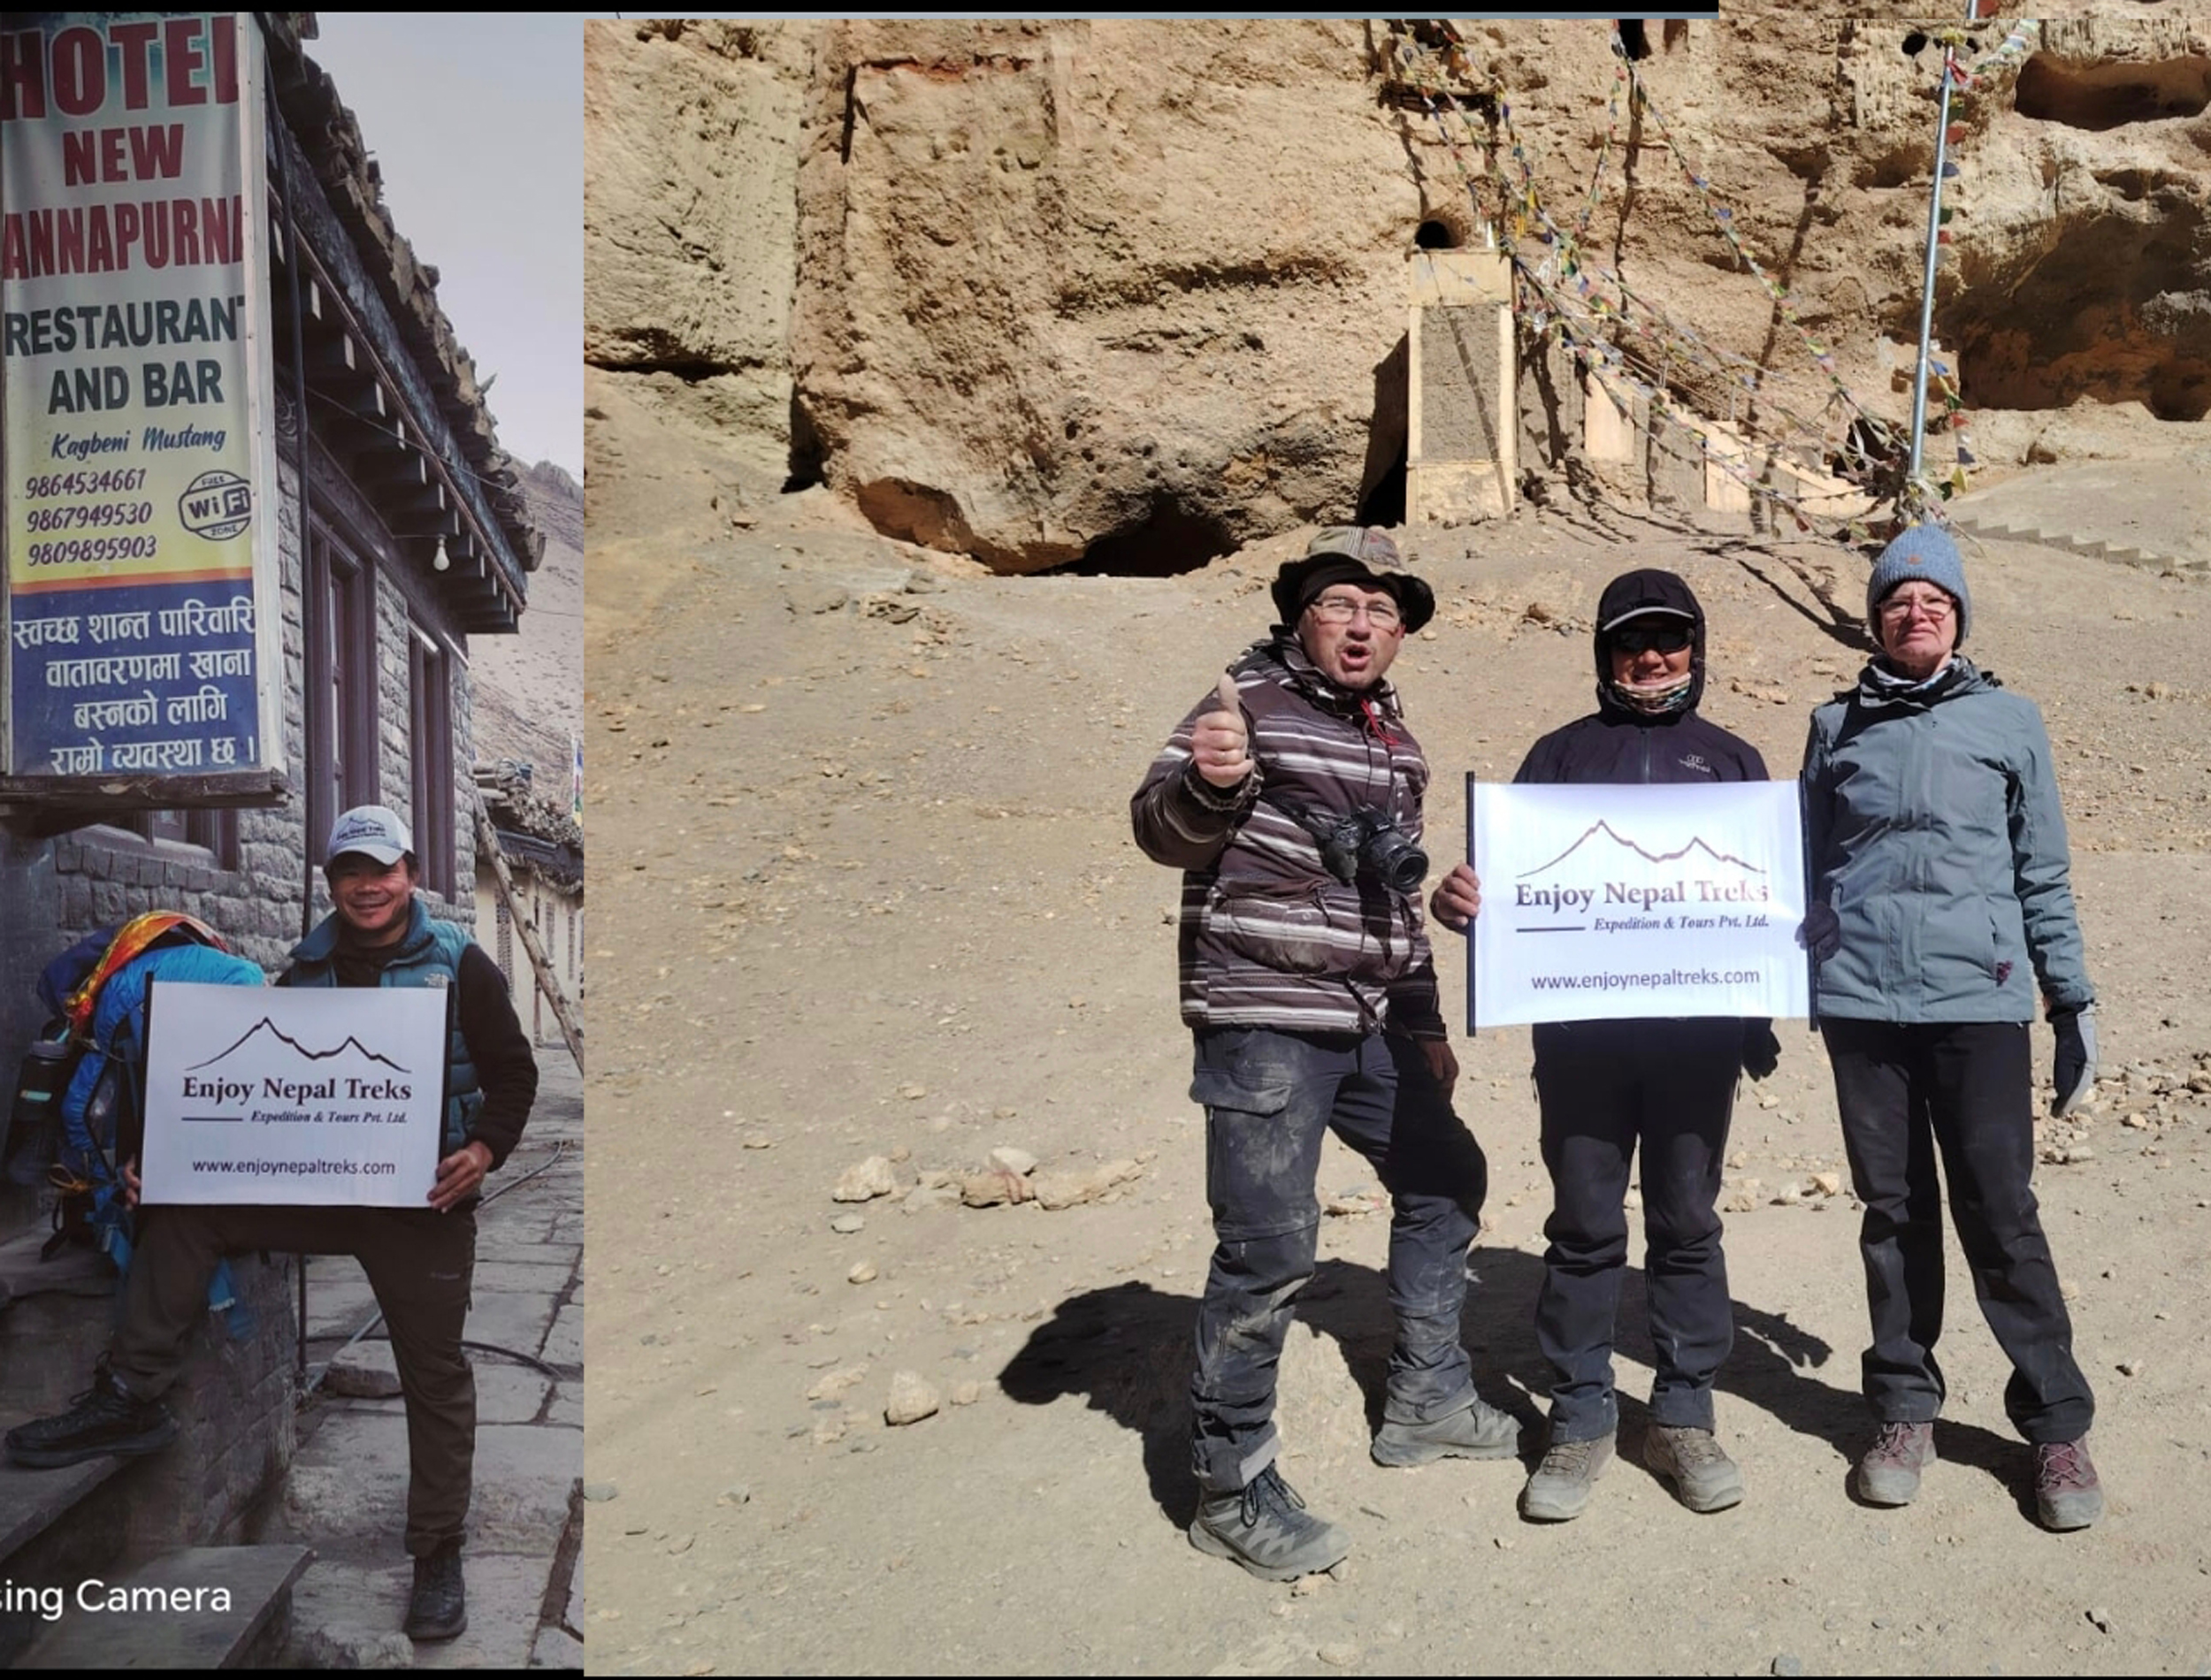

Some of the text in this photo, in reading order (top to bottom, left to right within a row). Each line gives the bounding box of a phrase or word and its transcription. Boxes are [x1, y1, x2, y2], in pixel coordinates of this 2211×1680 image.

[63, 124, 184, 187] NEW
[48, 359, 225, 415] AND BAR
[50, 423, 226, 462] Kagbeni Mustang
[25, 468, 147, 500] 9864534661
[27, 501, 153, 533] 9867949530
[27, 534, 157, 567] 9809895903
[13, 616, 80, 649] स्वच्छ
[88, 611, 150, 644] शान्त
[46, 648, 252, 688] वातावरणमा खाना
[73, 684, 228, 730] बस्नको लागि
[112, 738, 203, 769] व्यवस्था
[210, 737, 236, 765] छ
[1516, 882, 1595, 913] Enjoy
[1603, 881, 1686, 912] Nepal
[1594, 913, 1770, 934] Expedition & Tours Pvt. Ltd.
[1532, 969, 1760, 992] www.enjoynepaltreks.com
[182, 1076, 412, 1106] Enjoy Nepal Treks
[251, 1110, 408, 1125] Expedition & Tours Pvt. Ltd.
[192, 1157, 395, 1177] www.enjoynepaltreks.com
